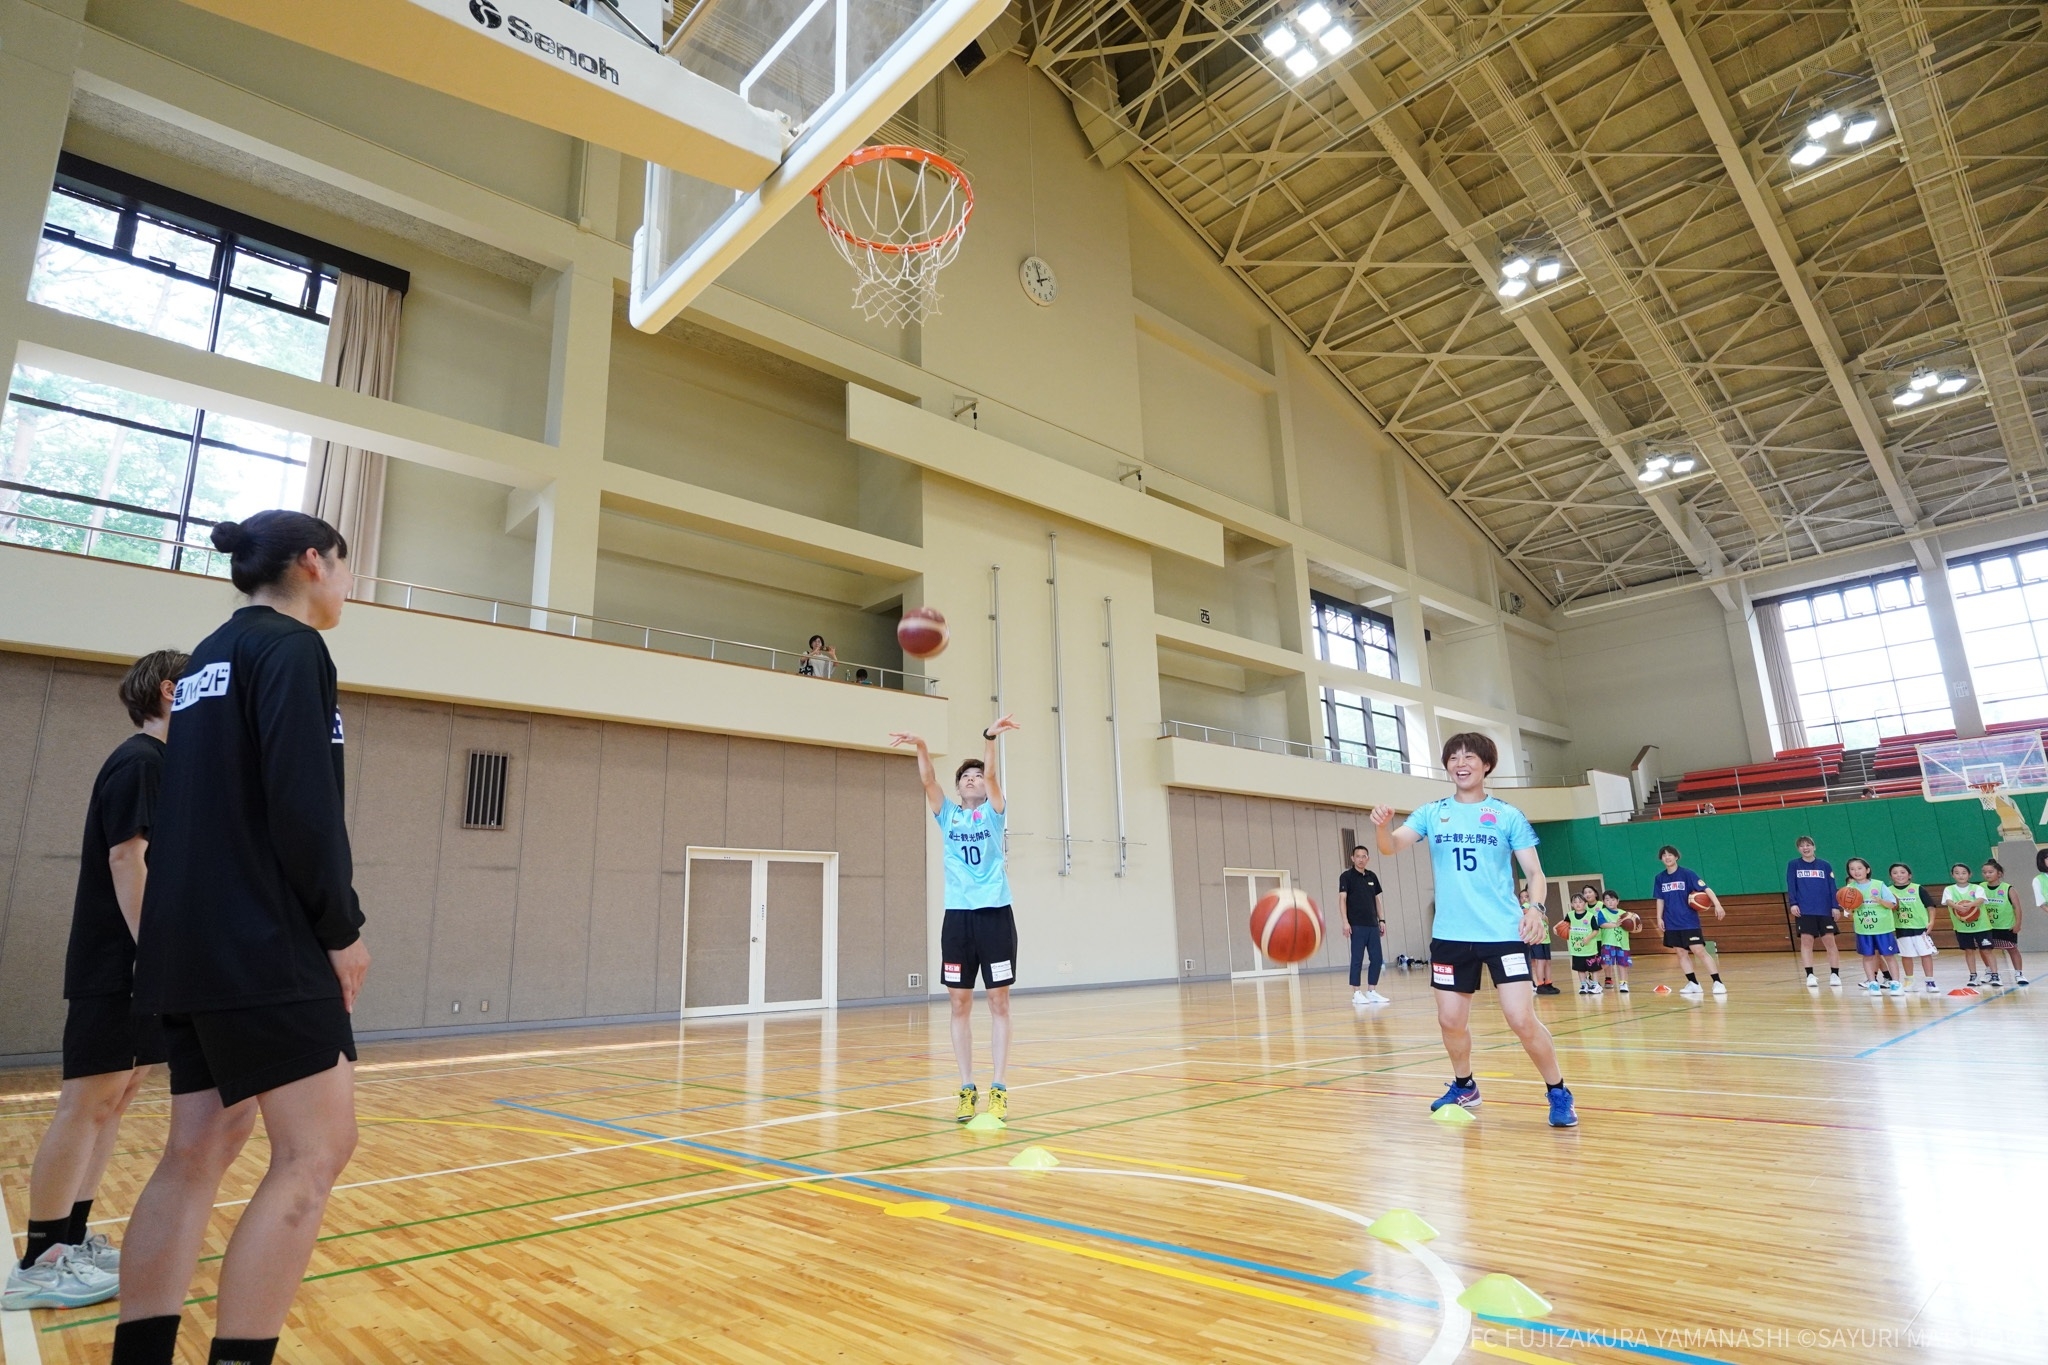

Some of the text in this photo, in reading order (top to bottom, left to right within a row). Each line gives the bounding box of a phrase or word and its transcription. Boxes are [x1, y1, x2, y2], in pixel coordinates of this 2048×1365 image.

[507, 15, 620, 86] Senoh
[1434, 833, 1498, 846] 富士観光開発
[961, 845, 981, 865] 10
[1452, 847, 1477, 872] 15
